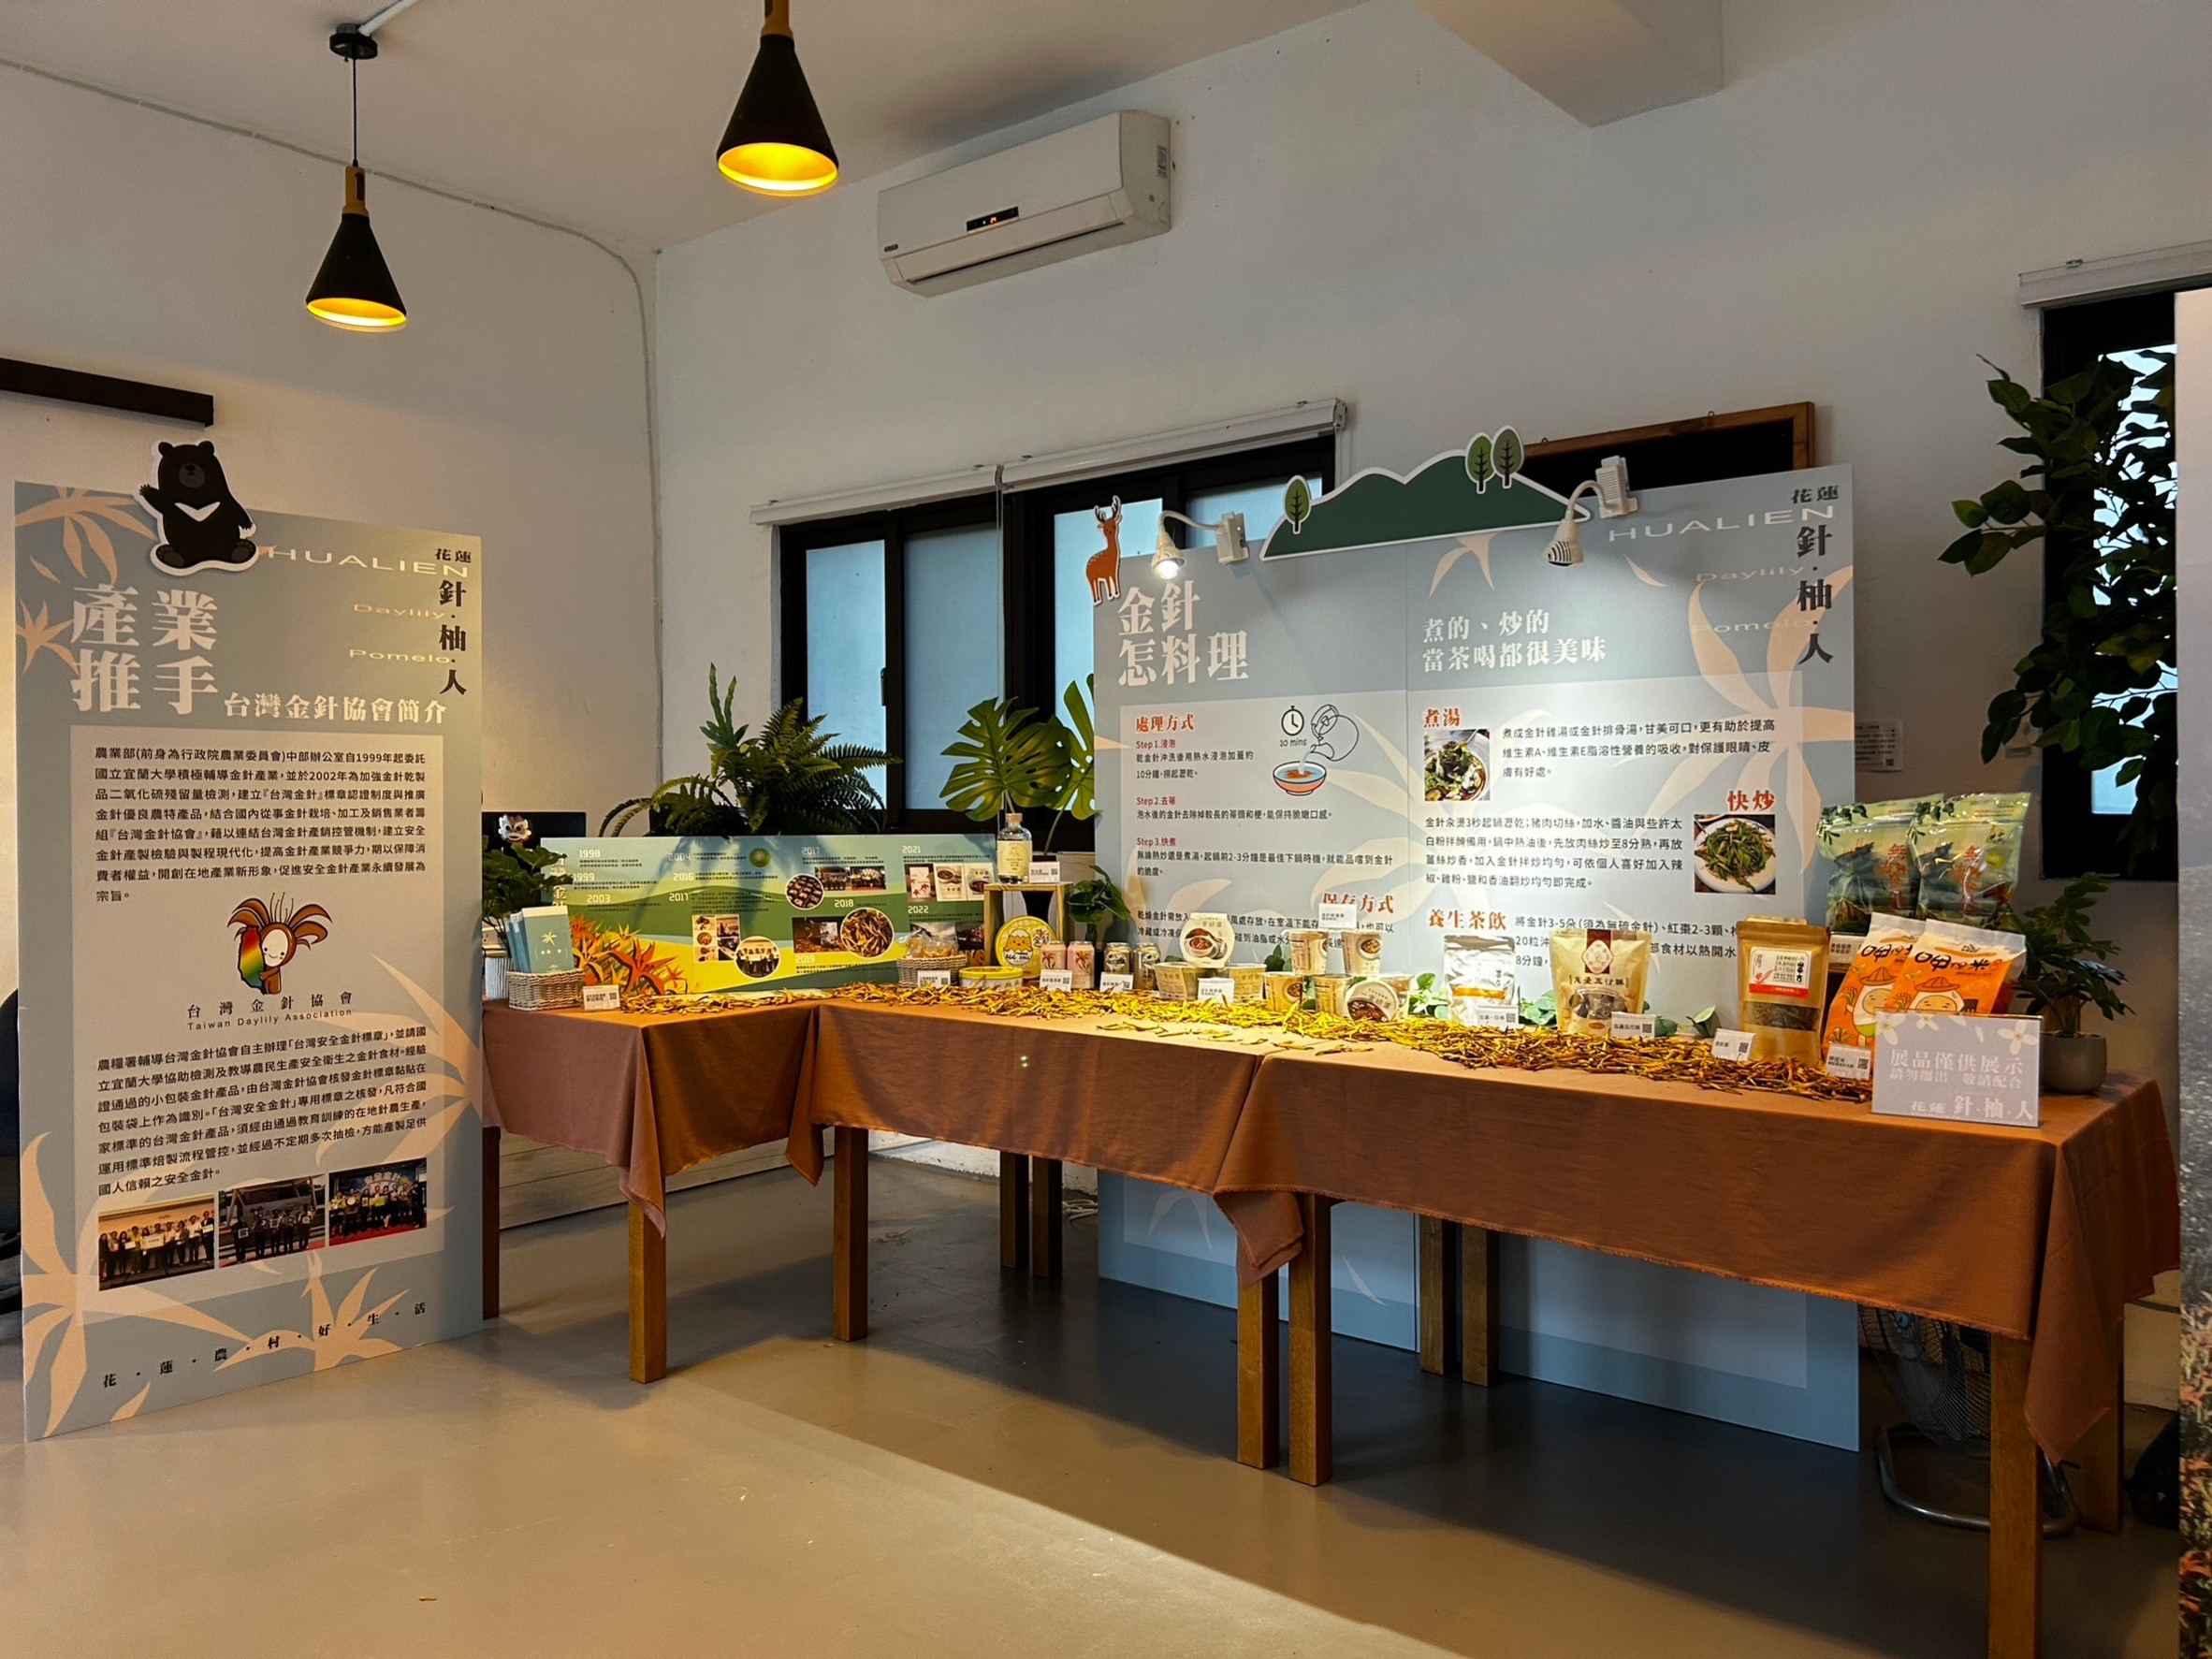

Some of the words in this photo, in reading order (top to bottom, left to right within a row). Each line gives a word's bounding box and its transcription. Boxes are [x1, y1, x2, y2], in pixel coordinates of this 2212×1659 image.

[1790, 485, 1840, 503] 花蓮
[1608, 505, 1834, 543] HUALIEN
[268, 548, 469, 577] HUALIEN
[434, 547, 472, 564] 花蓮
[1695, 566, 1804, 583] Daylily
[354, 604, 445, 619] Daylily
[1117, 579, 1201, 636] 金針
[71, 583, 218, 651] 產業
[1422, 608, 1550, 643] 煮的、炒的
[349, 649, 451, 663] Pomelo
[1117, 630, 1249, 687] 怎料理
[1422, 636, 1607, 673] 當茶喝都很美味
[71, 652, 218, 716] 推手
[224, 691, 447, 725] 台灣金針協會簡介
[1136, 714, 1194, 733] 處理方式
[1422, 707, 1461, 728] 煮湯
[1136, 740, 1153, 750] Step
[1290, 737, 1307, 747] mins
[1502, 766, 1552, 778] 膚有好處。
[1136, 797, 1153, 807] Step
[1726, 790, 1776, 812] 快炒
[1137, 837, 1153, 847] Step
[579, 849, 601, 858] 1998
[573, 873, 595, 881] 1999
[673, 872, 693, 881] 2016
[96, 890, 129, 902] 宗旨。
[587, 895, 611, 904] 2003
[669, 893, 689, 902] 2017
[834, 899, 853, 908] 2018
[908, 906, 929, 914] 2022
[1427, 908, 1507, 931] 養生茶飲
[795, 955, 815, 964] 2019
[187, 992, 352, 1018] 台灣金針協會
[188, 1019, 231, 1030] Taiwan
[238, 1015, 279, 1026] Daylily
[284, 1009, 352, 1022] Association
[1889, 1049, 2024, 1075] 展品僅供展示
[1911, 1100, 1946, 1113] 花蓮
[98, 1168, 221, 1196] 國人信賴之安全金針。
